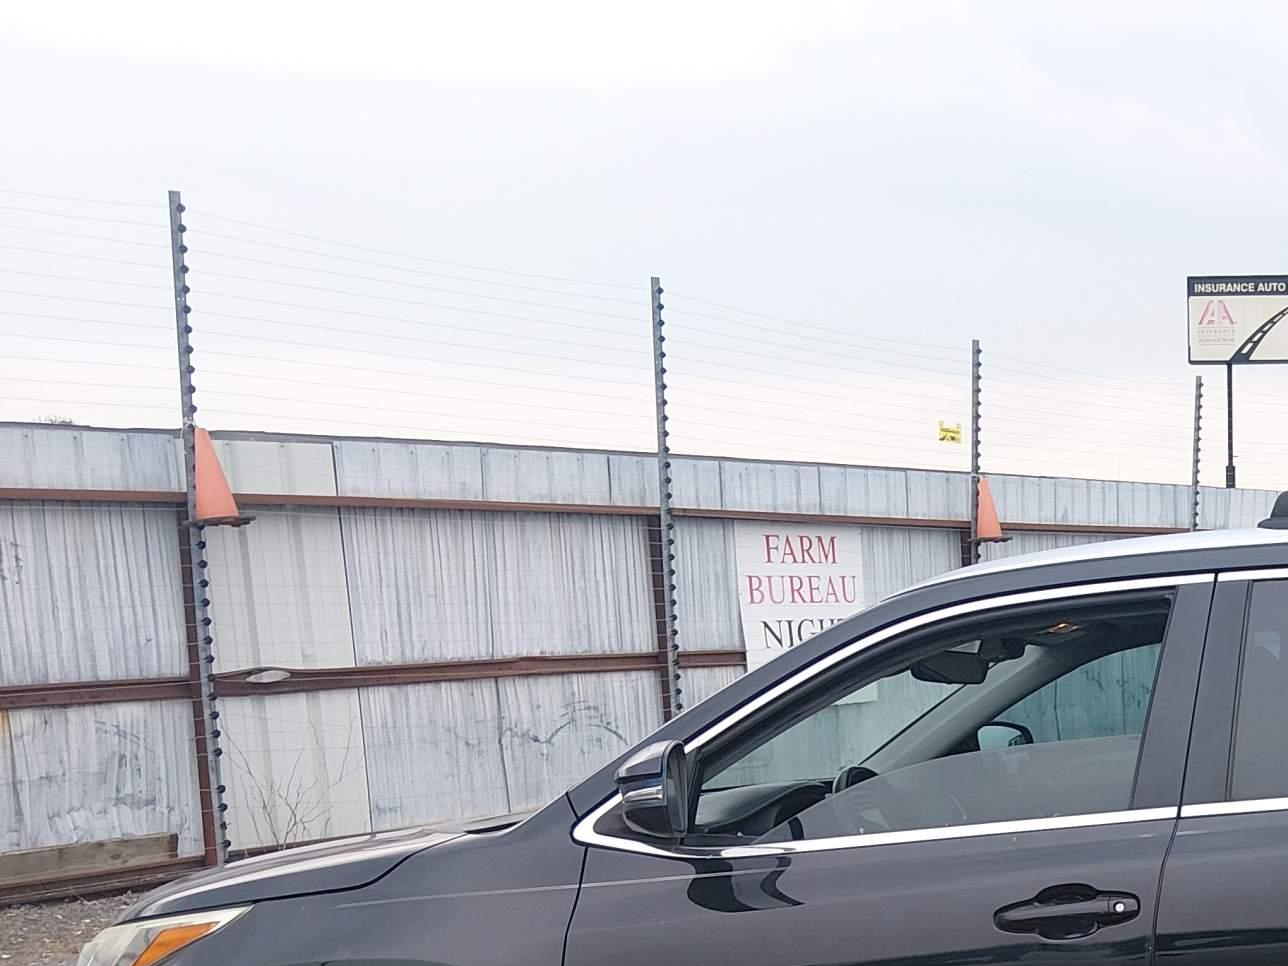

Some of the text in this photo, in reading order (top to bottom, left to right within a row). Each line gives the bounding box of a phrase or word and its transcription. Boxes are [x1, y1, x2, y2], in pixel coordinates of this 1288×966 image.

[1194, 283, 1255, 293] INSURANCE
[1257, 282, 1286, 292] AUTO
[763, 534, 838, 564] FARM
[746, 574, 857, 605] BUREAU
[761, 618, 848, 649] NIG
